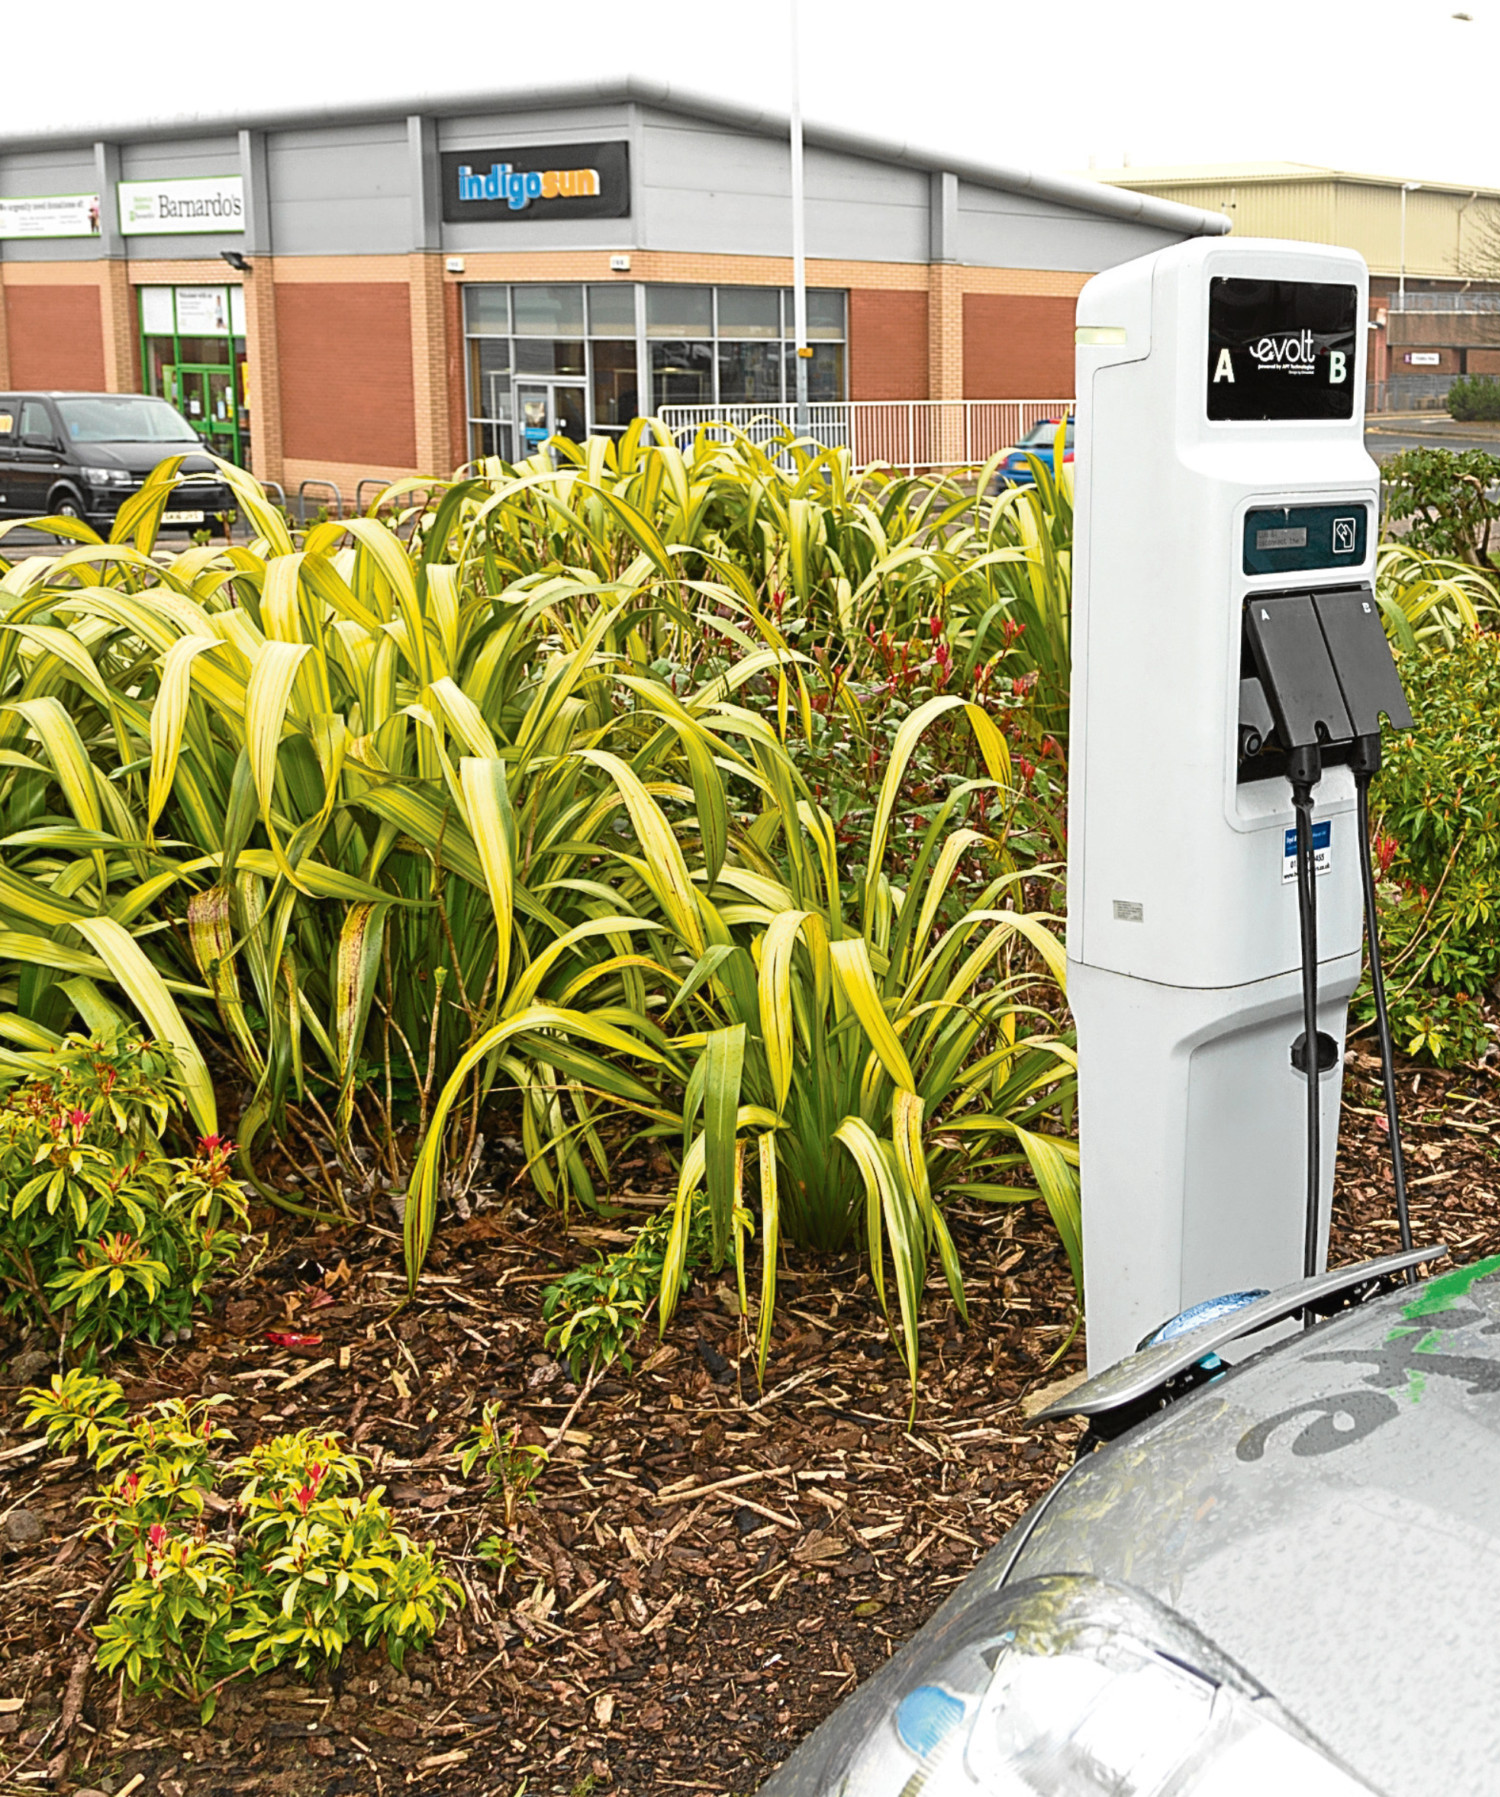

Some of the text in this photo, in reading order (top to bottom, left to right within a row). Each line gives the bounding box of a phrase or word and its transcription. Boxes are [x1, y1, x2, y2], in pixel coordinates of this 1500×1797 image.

[458, 163, 600, 211] indigosun
[158, 192, 242, 219] Barnardo's
[1249, 329, 1316, 363] evolt
[1213, 348, 1235, 384] A
[1329, 350, 1347, 384] B
[1261, 608, 1271, 621] A
[1362, 602, 1372, 614] B
